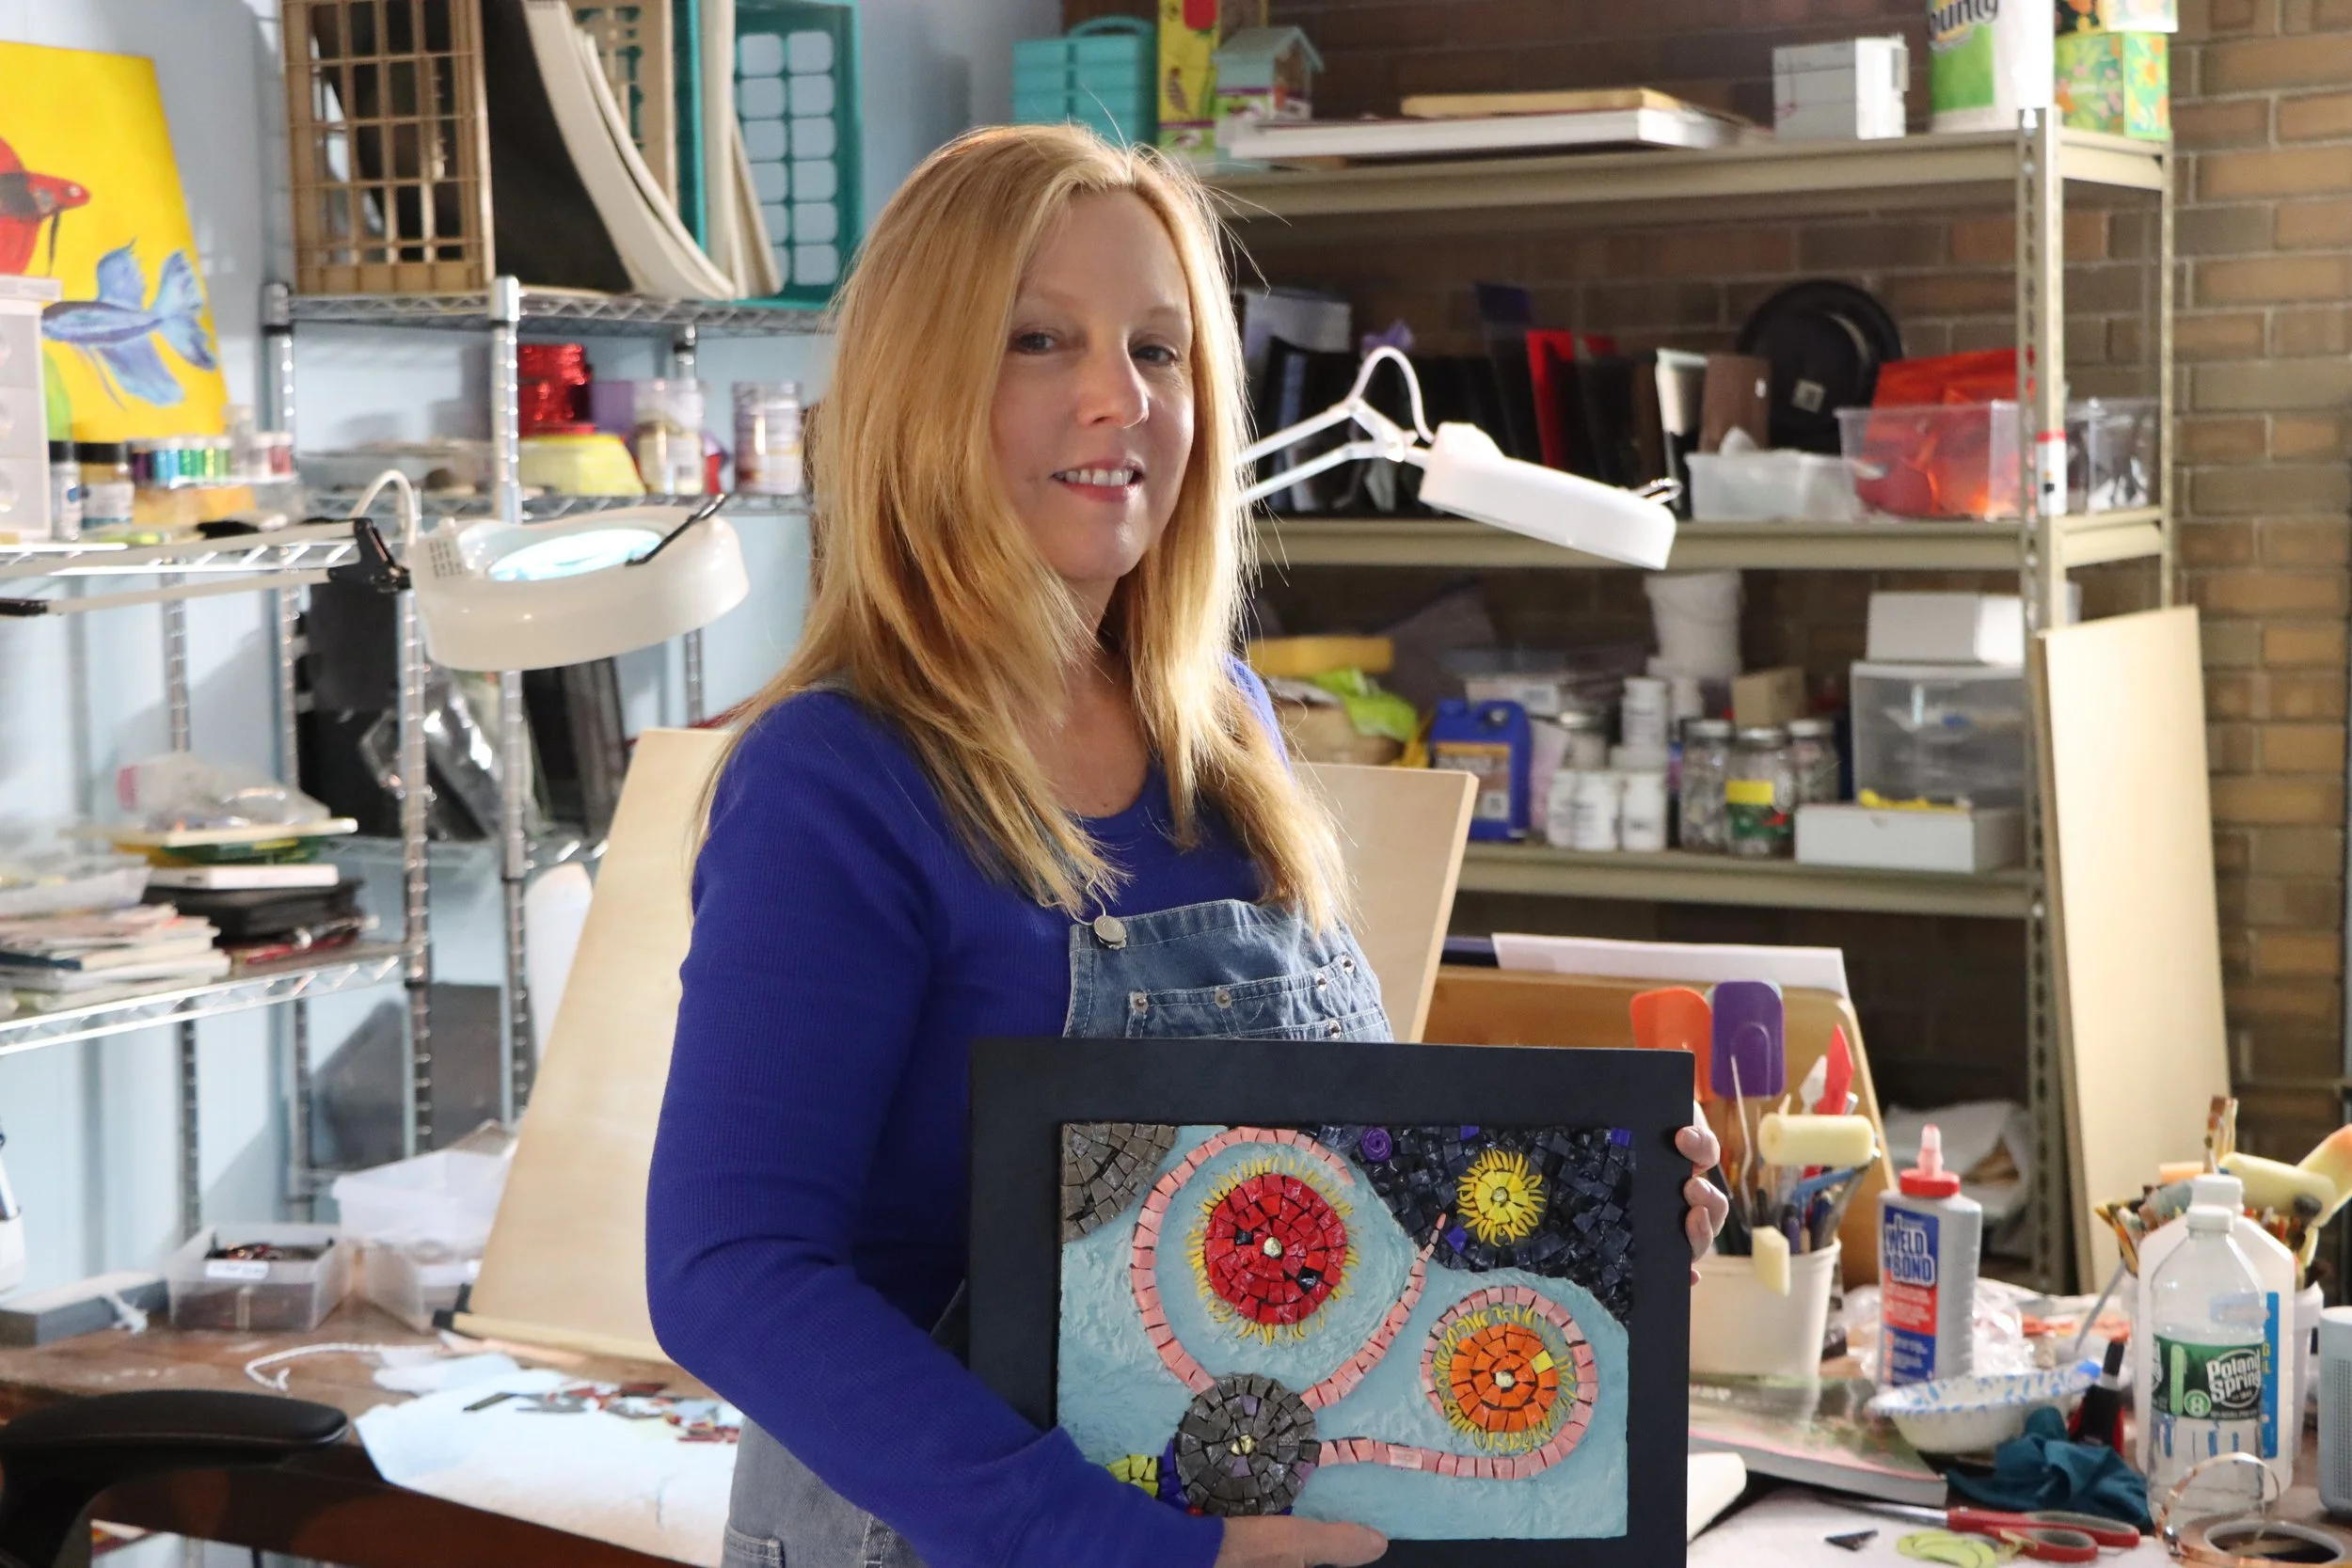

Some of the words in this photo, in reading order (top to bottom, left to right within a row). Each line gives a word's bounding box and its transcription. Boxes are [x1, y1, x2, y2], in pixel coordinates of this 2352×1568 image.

[1883, 1216, 1927, 1258] WELD
[1890, 1254, 1935, 1284] BOND
[2205, 1349, 2261, 1382] Poland
[2208, 1370, 2262, 1402] Spring
